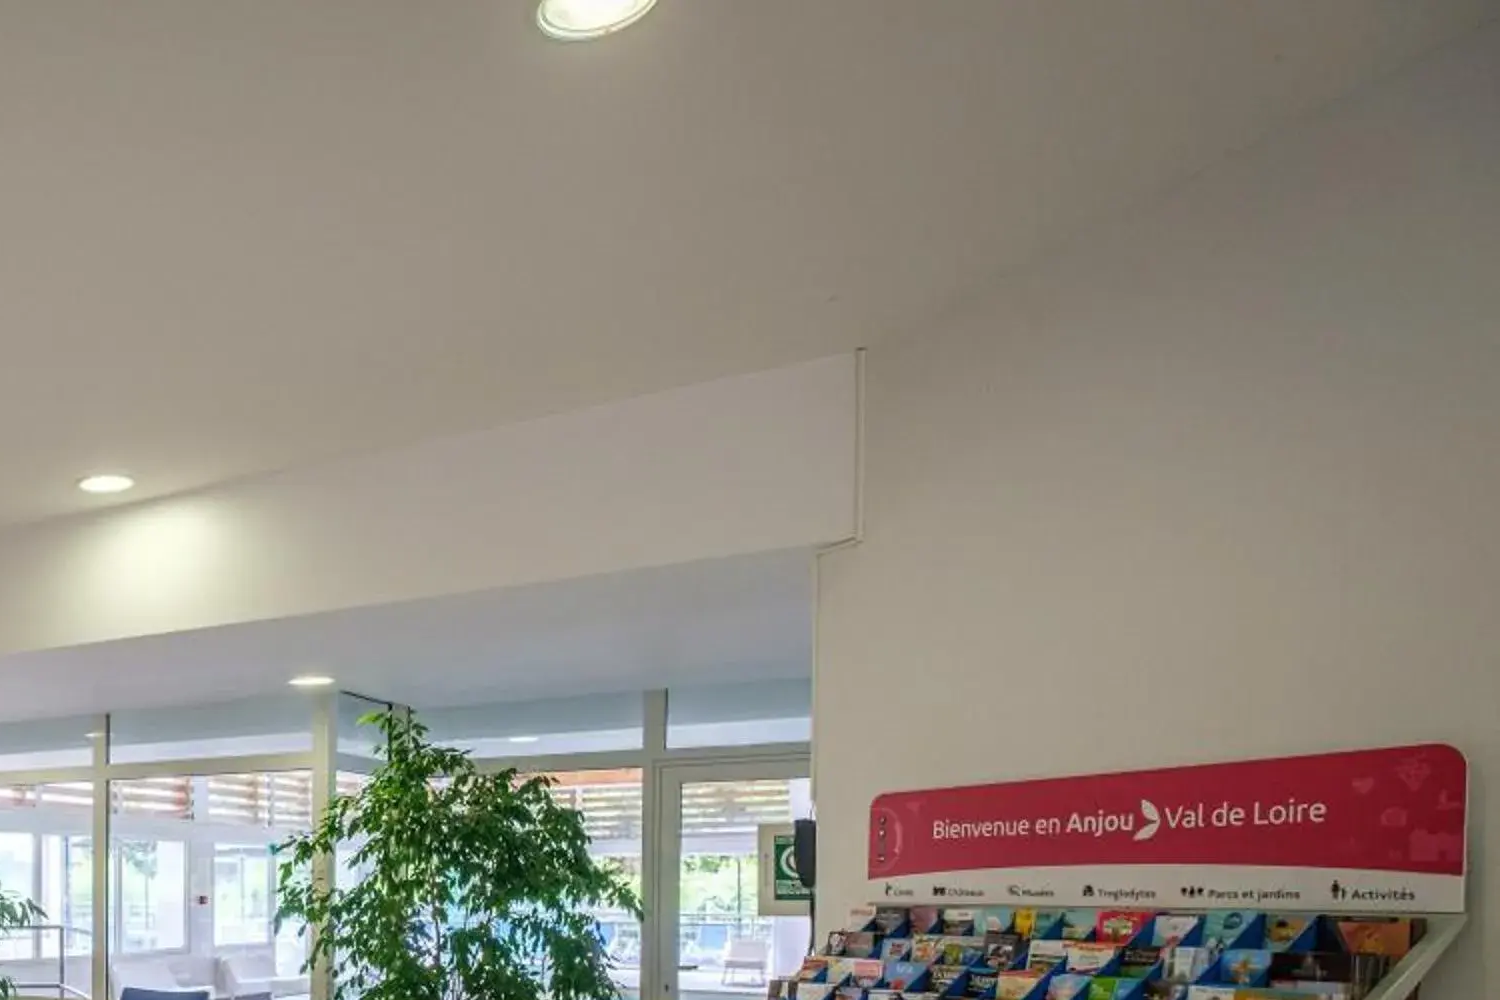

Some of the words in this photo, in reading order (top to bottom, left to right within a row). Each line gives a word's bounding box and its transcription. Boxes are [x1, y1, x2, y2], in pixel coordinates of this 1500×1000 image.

[932, 818, 1029, 839] Bienvenue
[1036, 820, 1060, 835] en
[1066, 810, 1134, 838] Anjou
[1165, 803, 1205, 829] Val
[1211, 801, 1245, 827] de
[1253, 798, 1328, 825] Loire
[1207, 888, 1238, 900] Parcs
[1241, 888, 1255, 899] et
[1256, 886, 1301, 902] jardins
[1350, 884, 1416, 901] Activités
